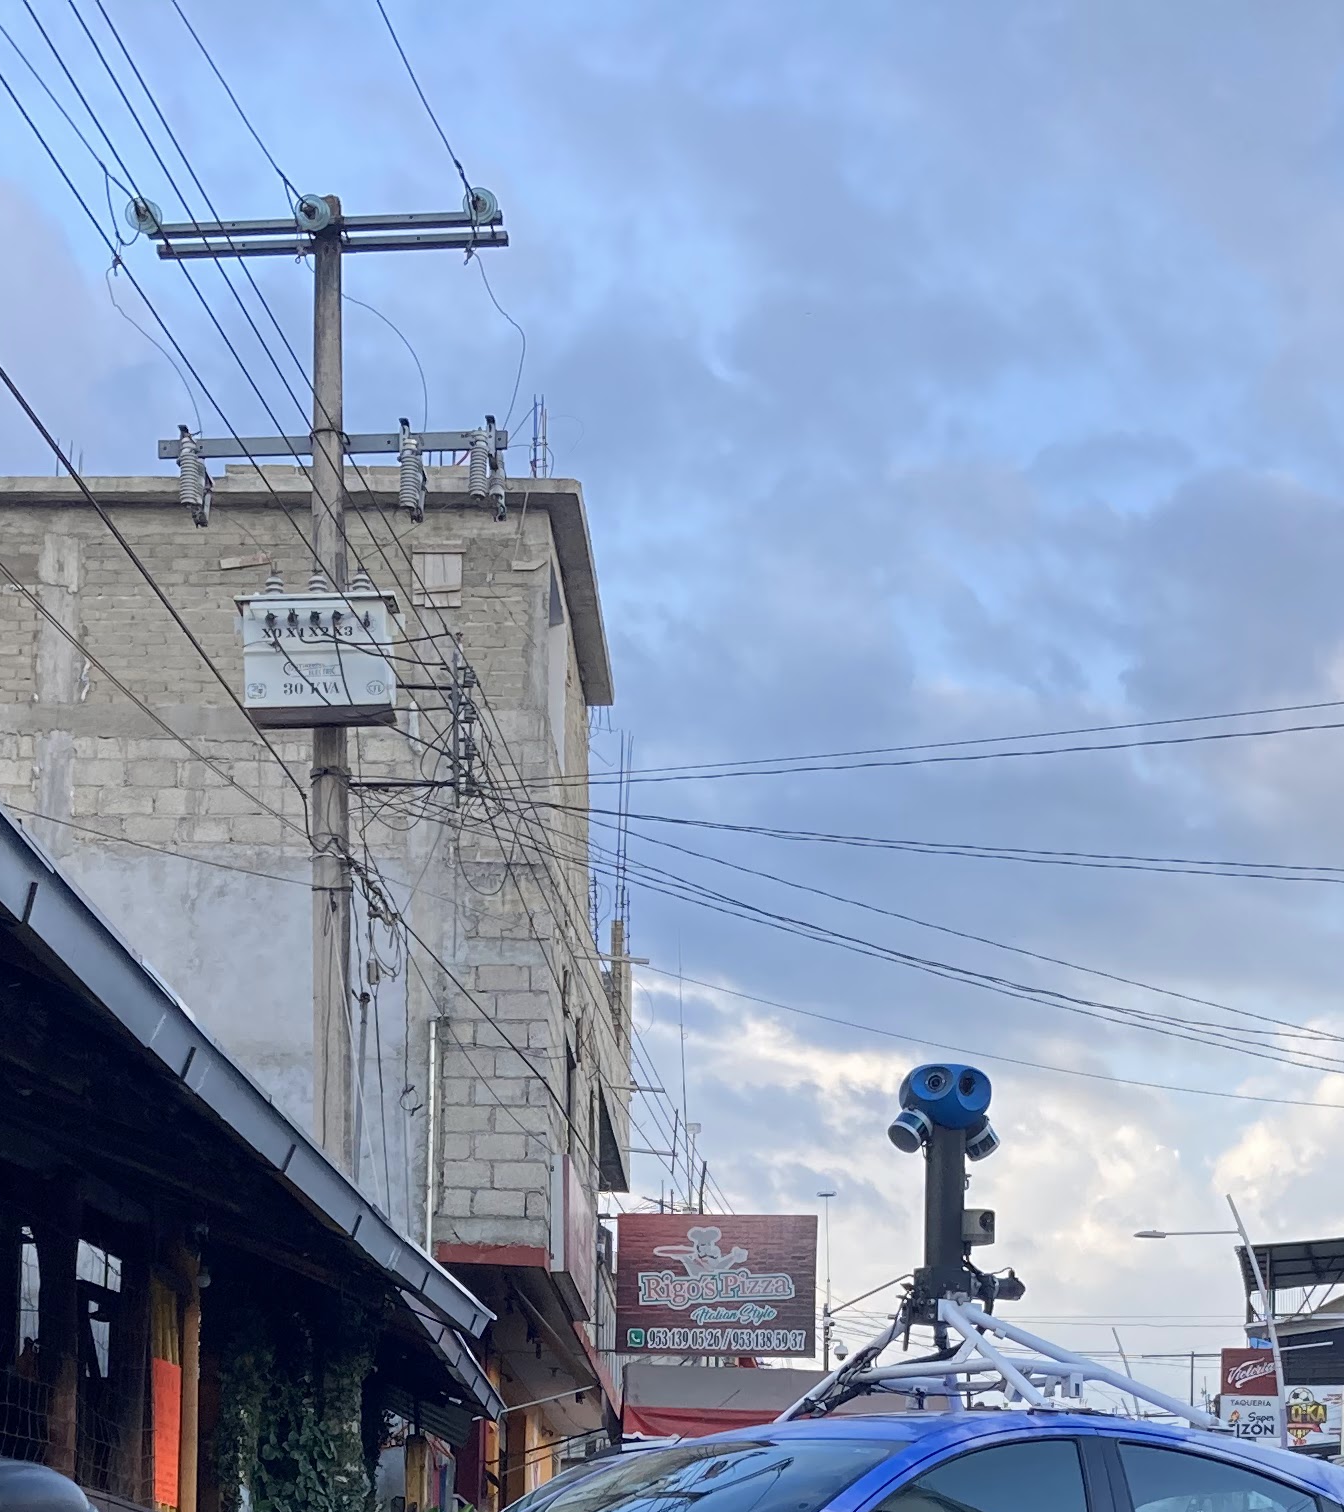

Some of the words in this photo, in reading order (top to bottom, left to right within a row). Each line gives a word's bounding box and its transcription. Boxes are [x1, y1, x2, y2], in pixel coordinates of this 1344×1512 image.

[283, 682, 304, 695] 30
[721, 1271, 788, 1297] Pizza
[692, 1306, 738, 1324] Italian
[738, 1303, 777, 1325] Style
[649, 1330, 669, 1348] 953
[671, 1330, 689, 1348] 139
[692, 1331, 704, 1348] 05
[707, 1331, 721, 1348] 26
[733, 1331, 752, 1349] 953
[756, 1331, 773, 1349] 138
[775, 1332, 788, 1349] 59
[791, 1332, 804, 1349] 37
